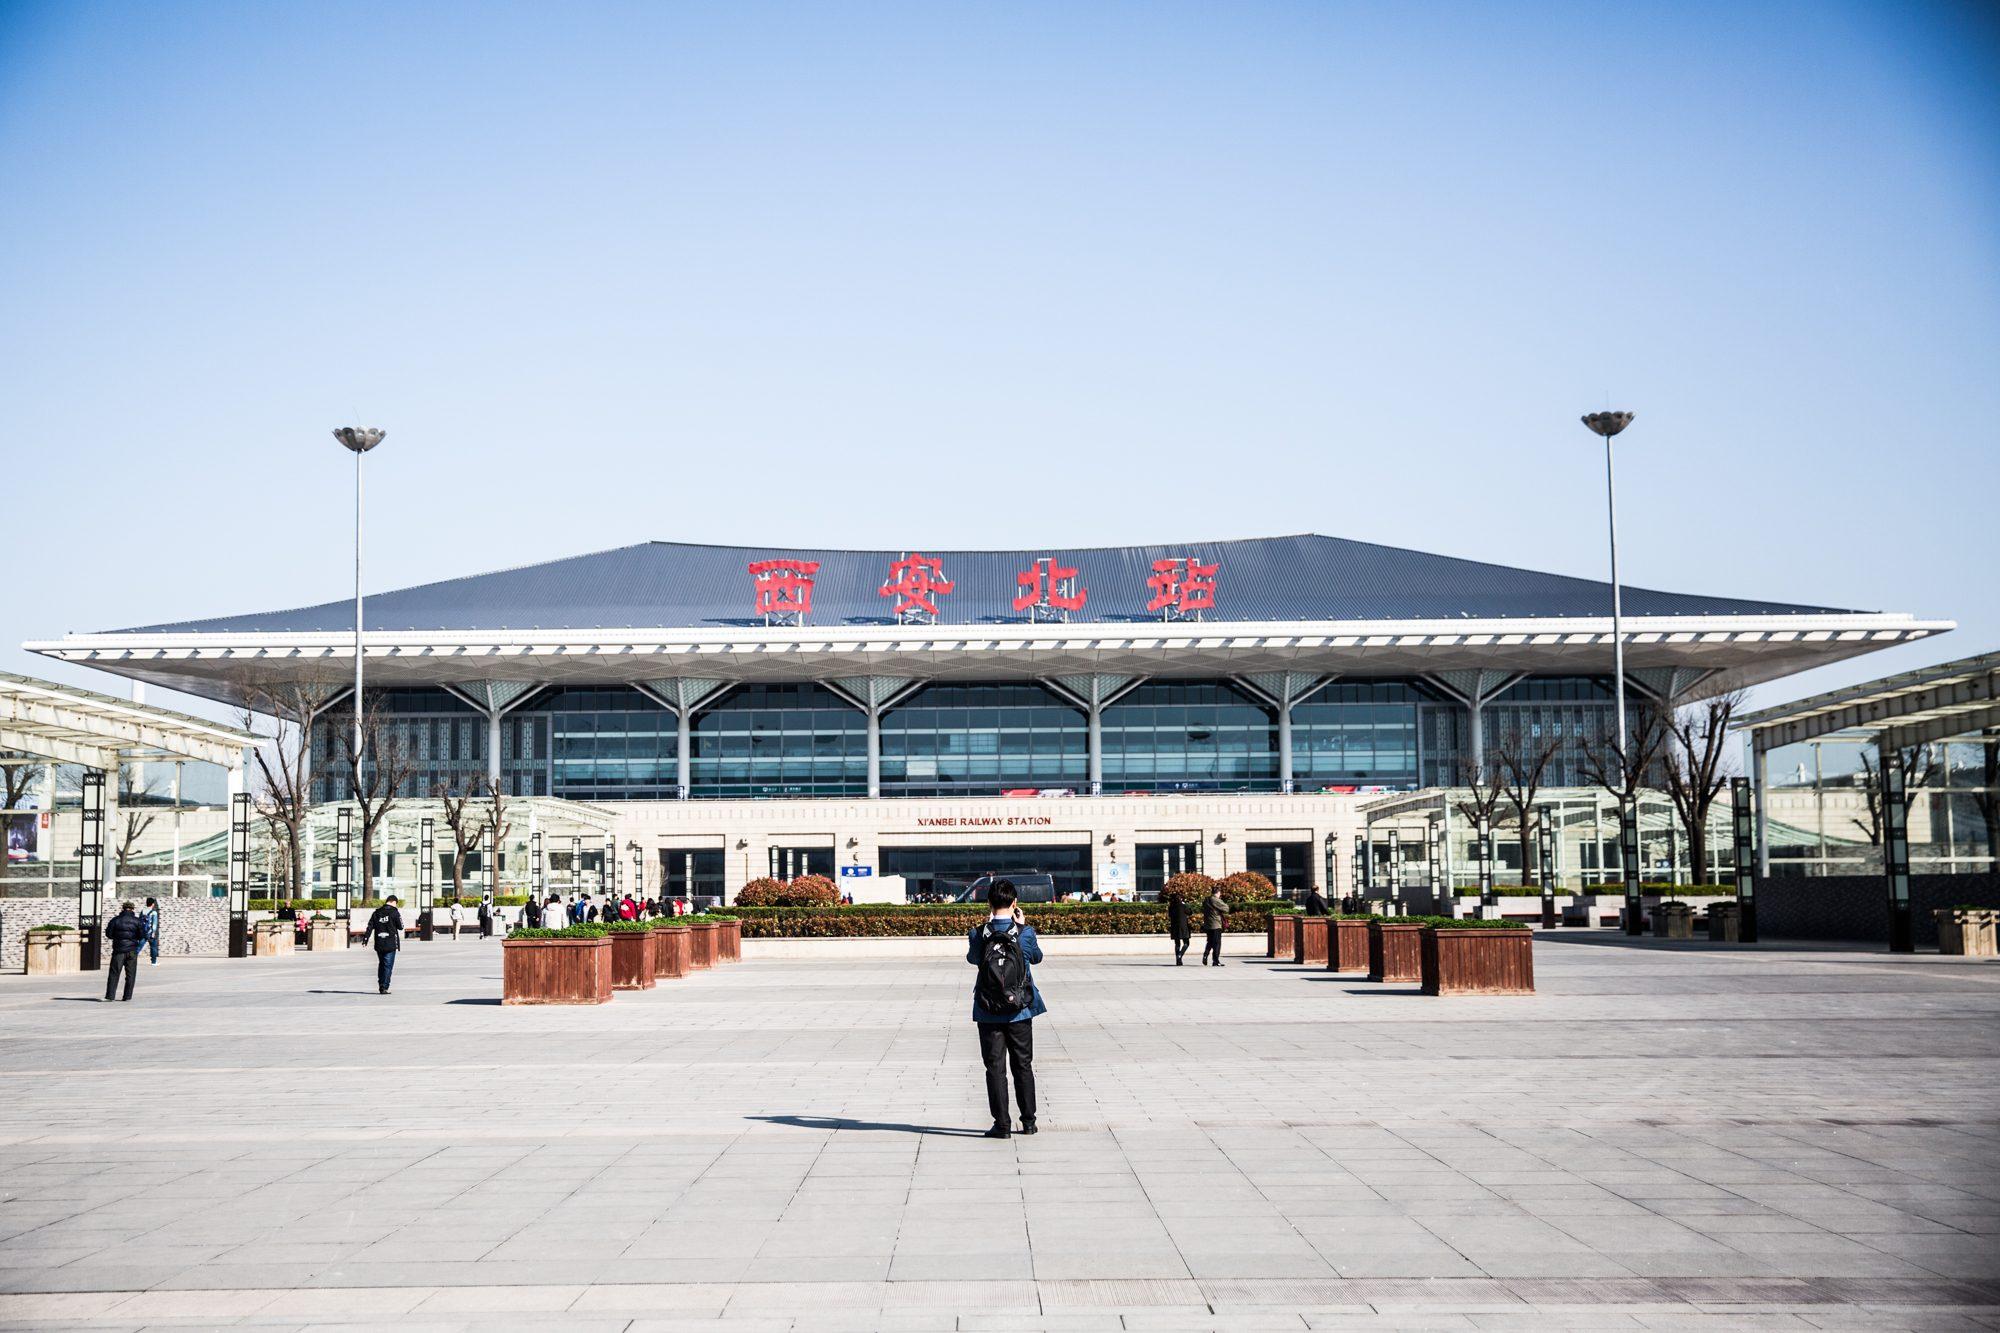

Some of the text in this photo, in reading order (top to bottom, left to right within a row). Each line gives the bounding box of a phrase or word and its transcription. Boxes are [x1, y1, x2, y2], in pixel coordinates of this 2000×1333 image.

[749, 553, 1219, 614] 西安北站
[917, 816, 1051, 826] XI'ANBEI RAILWAY STATION
